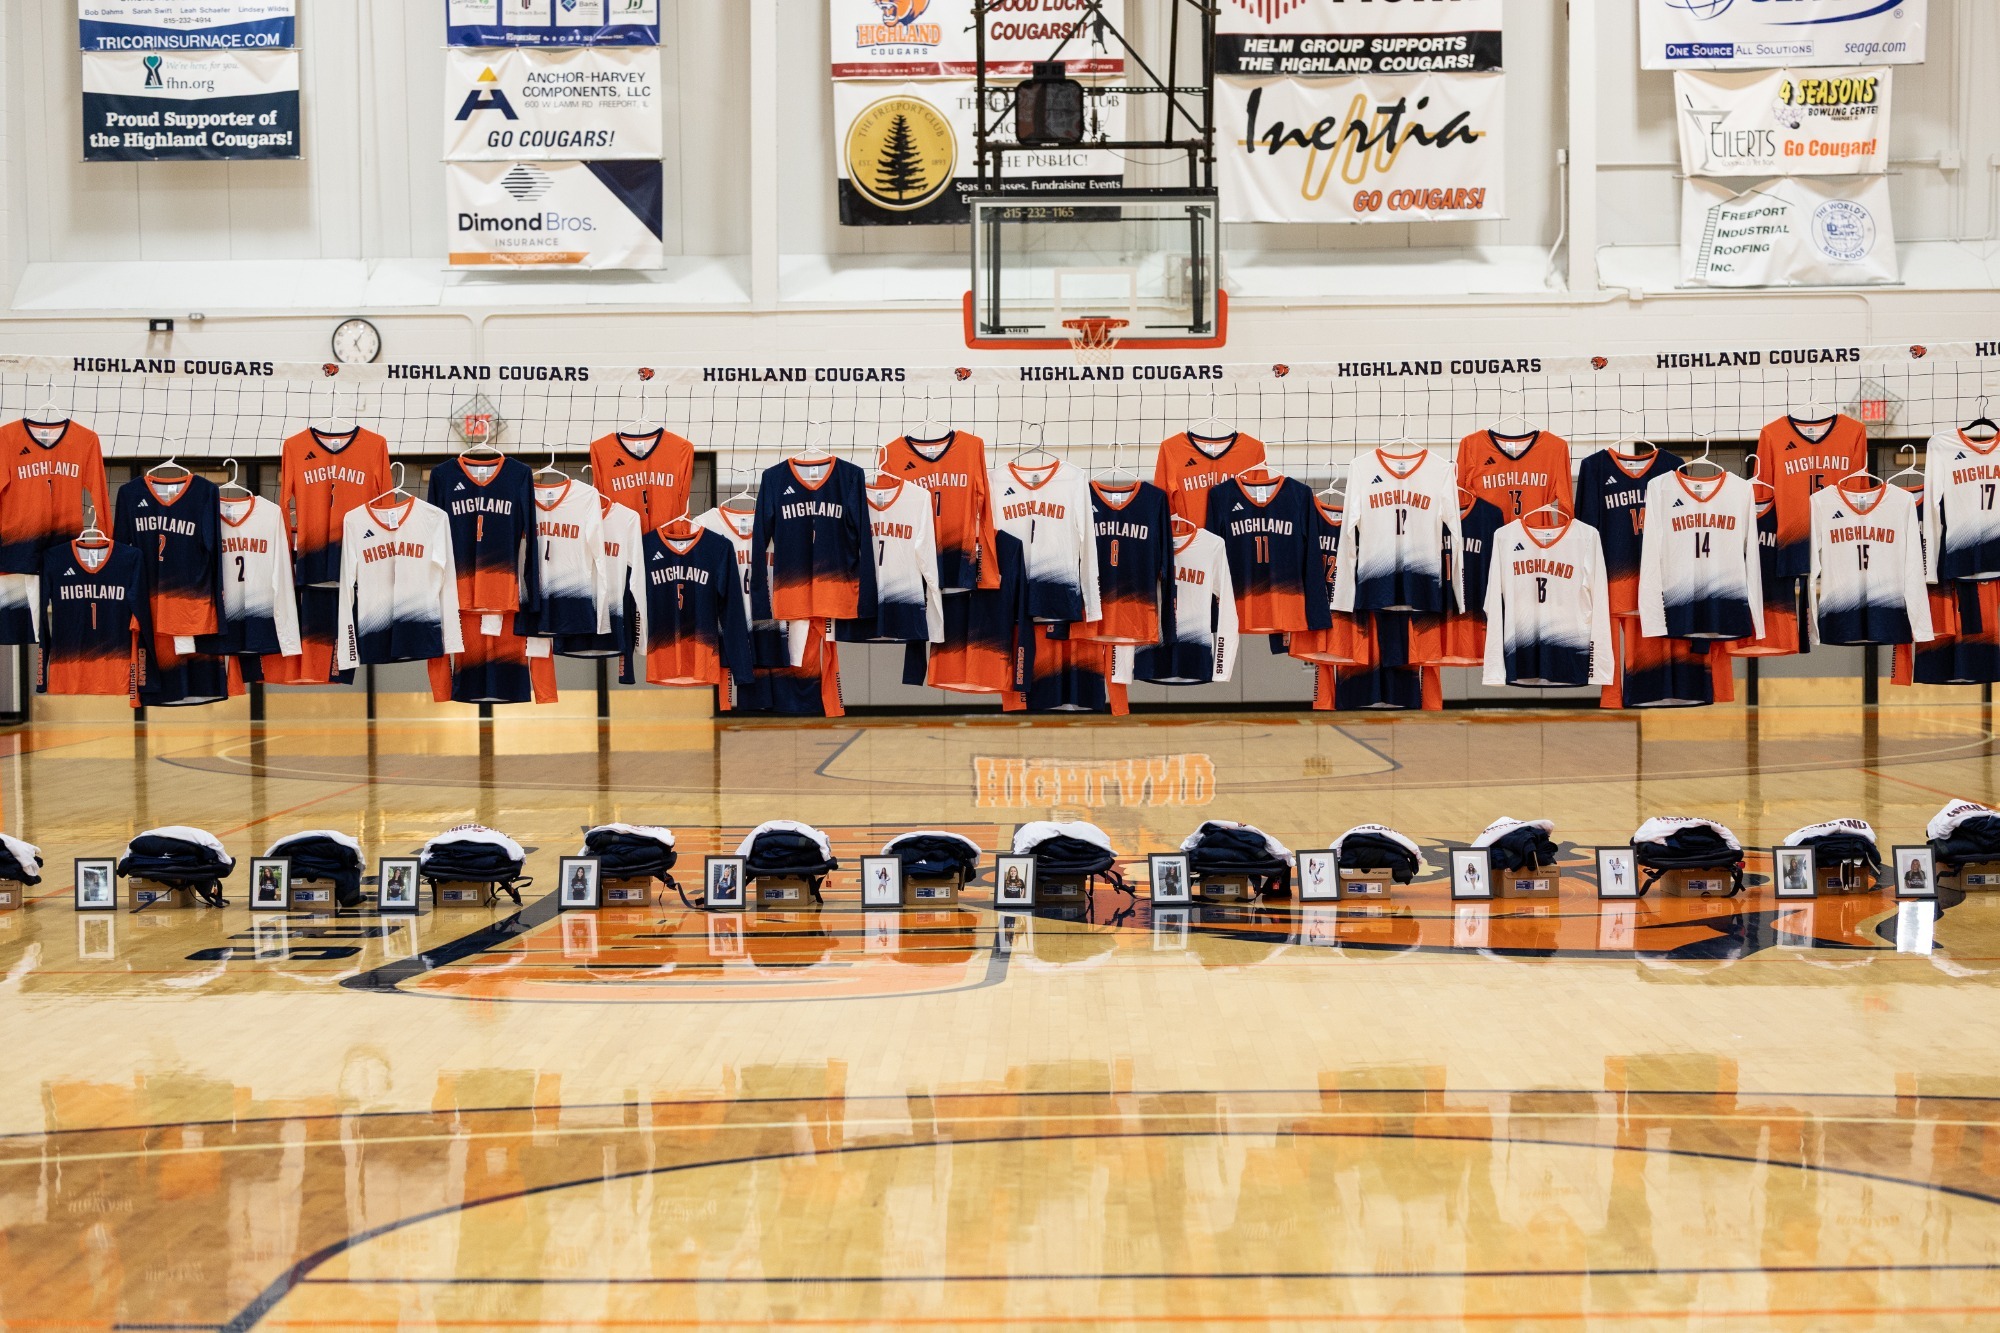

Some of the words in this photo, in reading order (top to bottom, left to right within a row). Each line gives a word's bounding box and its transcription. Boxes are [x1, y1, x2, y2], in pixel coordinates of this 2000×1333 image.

[101, 8, 124, 16] Dahms
[238, 6, 264, 14] Lindsey
[96, 33, 280, 50] TRICORINSURNACE.COM
[857, 24, 942, 47] HIGHLAND
[1244, 38, 1294, 52] HELM
[1300, 38, 1365, 53] GROUP
[1370, 36, 1467, 53] SUPPORTS
[871, 48, 928, 56] COUGARS
[1666, 44, 1689, 56] ONE
[1692, 44, 1733, 56] SOURCE
[1735, 45, 1752, 55] ALL
[1756, 44, 1812, 55] SOLUTIONS
[1844, 41, 1906, 55] seaga.com
[209, 61, 221, 72] for
[1238, 56, 1274, 71] THE
[1280, 56, 1373, 72] HIGHLAND
[1379, 54, 1475, 70] COUGARS!
[166, 76, 214, 92] fhn.org
[527, 72, 646, 84] ANCHOR-HARVEY
[522, 86, 621, 98] COMPONENTS,
[627, 86, 651, 97] LLC
[1778, 79, 1794, 106] 4
[1796, 76, 1878, 106] SEASONS
[105, 112, 160, 127] Proud
[164, 111, 255, 128] Supporter
[258, 110, 278, 126] of
[858, 118, 874, 138] THE
[873, 102, 924, 121] FREEPORT
[924, 110, 945, 138] CLUB
[1246, 87, 1479, 155] Inertia
[1808, 107, 1847, 116] BOWLING
[89, 132, 120, 148] the
[123, 131, 208, 150] Highland
[211, 130, 293, 148] Cougars!
[487, 130, 514, 148] GO
[519, 130, 616, 148] COUGARS!
[1710, 121, 1776, 158] EILERTS
[1784, 139, 1805, 156] Go
[1027, 154, 1089, 166] PUBLIC!
[1031, 180, 1086, 190] Fundraising
[1089, 180, 1121, 190] Events
[1353, 190, 1383, 212] GO
[1386, 188, 1486, 211] COUGARS!
[1721, 206, 1788, 221] FREEPORT
[1816, 206, 1828, 220] THE
[1828, 202, 1866, 220] WORLD'S
[458, 212, 542, 231] Dimond
[546, 212, 597, 231] Bros.
[1717, 225, 1790, 238] INDUSTRIAL
[494, 238, 559, 247] INSURANCE
[1714, 244, 1770, 256] ROOFING
[1710, 263, 1735, 272] INC.
[73, 357, 176, 374] HIGHLAND
[184, 360, 274, 376] COUGARS
[1338, 362, 1443, 378] HIGHLAND
[1450, 357, 1542, 374] COUGARS
[1656, 351, 1762, 368] HIGHLAND
[1769, 347, 1861, 365] COUGARS
[387, 364, 492, 381] HIGHLAND
[498, 366, 590, 382] COUGARS
[703, 366, 807, 382] HIGHLAND
[814, 366, 906, 382] COUGARS
[1020, 366, 1125, 381] HIGHLAND
[1132, 364, 1224, 380] COUGARS
[1862, 398, 1887, 420] EXIT
[18, 460, 80, 480] HIGHLAND
[304, 464, 366, 486] HIGHLAND
[1784, 455, 1850, 476] HIGHLAND
[1952, 464, 2000, 485] HIGHLA
[612, 471, 674, 492] HIGHLAND
[1482, 472, 1548, 489] HIGHLAND
[451, 496, 512, 516] HIGHLAND
[1369, 489, 1431, 511] HIGHLAND
[1508, 490, 1522, 516] 13
[1980, 484, 1996, 511] 17
[781, 500, 843, 520] HIGHLAND
[1002, 500, 1066, 520] HIGHLAND
[135, 516, 196, 536] HIGHLAND
[476, 514, 484, 542] 4
[1230, 518, 1294, 536] HIGHLAND
[1630, 508, 1646, 536] 14
[1672, 512, 1736, 532] HIGHLAND
[1830, 525, 1896, 544] HIGHLAND
[158, 534, 166, 562] 2
[362, 541, 424, 564] HIGHLAND
[1110, 539, 1120, 567] 8
[1254, 536, 1270, 564] 11
[1695, 531, 1710, 559] 14
[1857, 544, 1870, 571] 15
[235, 556, 245, 582] 2
[650, 565, 709, 586] HIGHLAND
[1512, 558, 1574, 580] HIGHLAND
[60, 584, 125, 600] HIGHLAND
[676, 583, 684, 611] 5
[90, 602, 97, 630] 1
[348, 624, 357, 662] COUGARS
[1216, 636, 1224, 674] COUGARS
